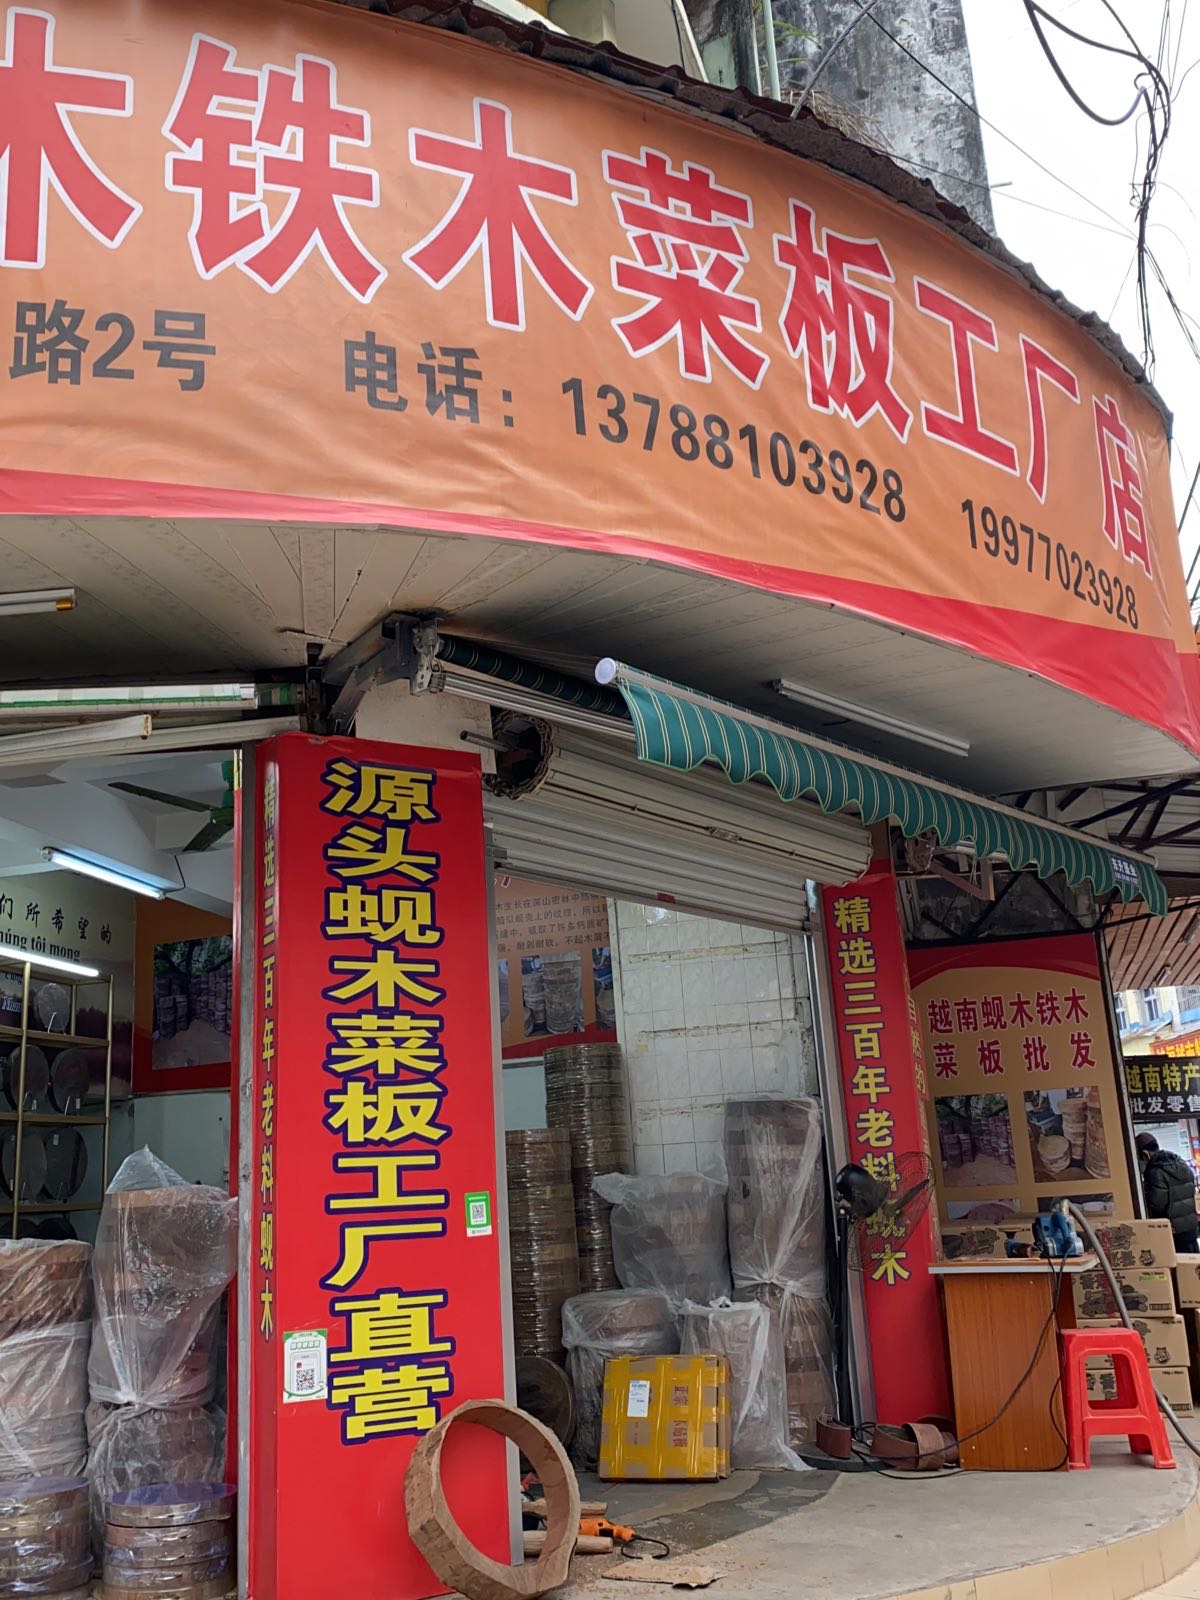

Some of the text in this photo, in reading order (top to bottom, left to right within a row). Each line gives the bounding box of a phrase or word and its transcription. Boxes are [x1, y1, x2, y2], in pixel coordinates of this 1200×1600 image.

[0, 8, 1153, 579] 木铁木菜板工厂店
[9, 299, 216, 391] 路2号
[562, 376, 907, 523] 13788103928
[961, 498, 1140, 630] 19977023928
[0, 893, 112, 944] 们所希望的
[31, 935, 46, 953] tôi
[49, 943, 80, 961] mong
[927, 987, 1090, 1035] 越南蚬木铁木
[932, 1031, 1096, 1079] 菜板批发
[1125, 1062, 1200, 1093] 越南特产
[320, 758, 455, 1446] 源头蚬木菜板工厂直营
[1129, 1094, 1200, 1114] 批发零售
